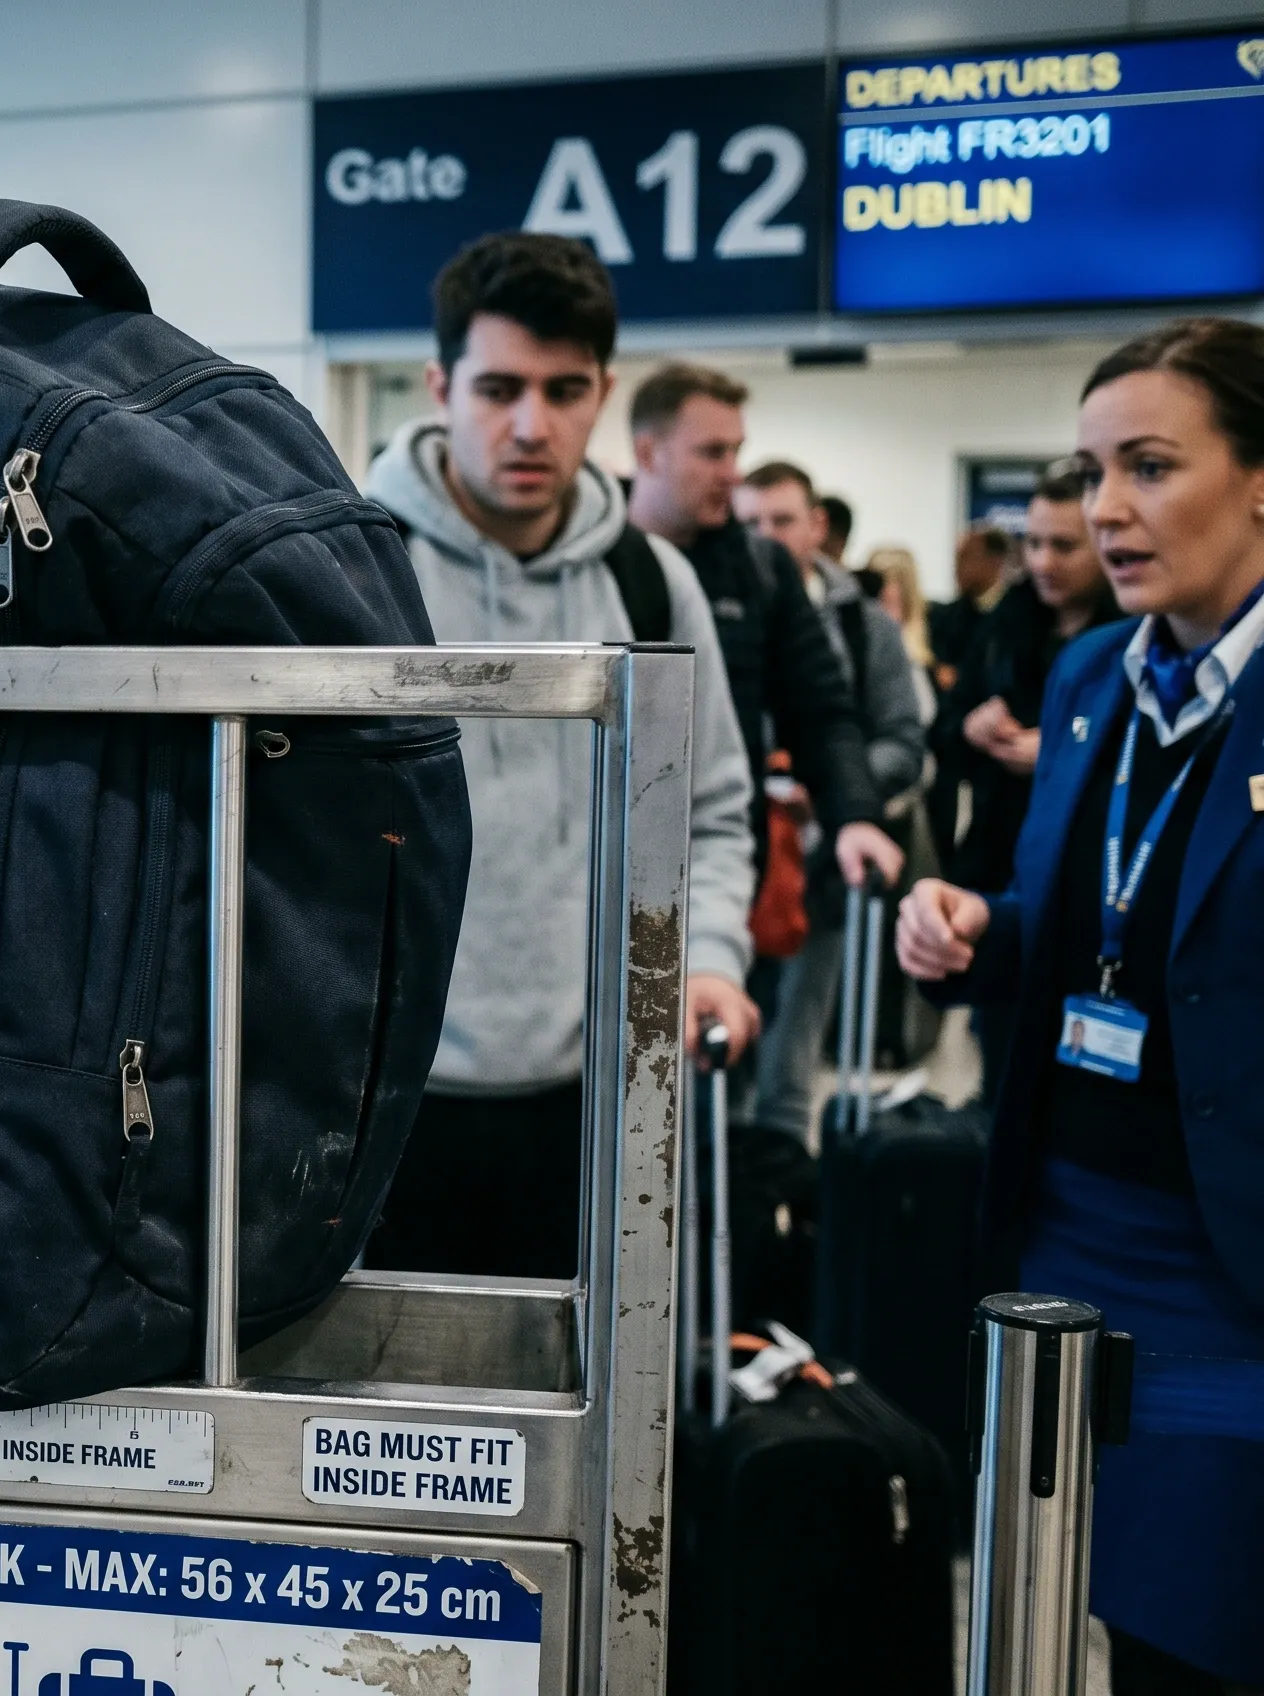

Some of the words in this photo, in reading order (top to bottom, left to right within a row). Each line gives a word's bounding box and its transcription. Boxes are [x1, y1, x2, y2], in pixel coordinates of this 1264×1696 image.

[845, 51, 1122, 110] DEPARTURES
[844, 123, 953, 174] Flight
[957, 112, 1111, 163] FR3201
[325, 146, 468, 205] Gate
[520, 124, 809, 265] A12
[842, 176, 1033, 232] DUBLIN
[3, 1439, 75, 1464] INSIDE
[81, 1444, 156, 1469] FRAME
[315, 1428, 371, 1458] BAG
[380, 1432, 462, 1463] MUST
[470, 1438, 513, 1466] FIT
[313, 1466, 407, 1498] INSIDE
[415, 1472, 513, 1505] FRAME
[36, 1564, 52, 1573] -
[64, 1548, 168, 1597] MAX:
[181, 1556, 233, 1602] 56
[244, 1572, 266, 1605] x
[277, 1564, 330, 1610] 45
[341, 1579, 364, 1612] x
[376, 1571, 428, 1617] 25
[440, 1587, 500, 1622] cm
